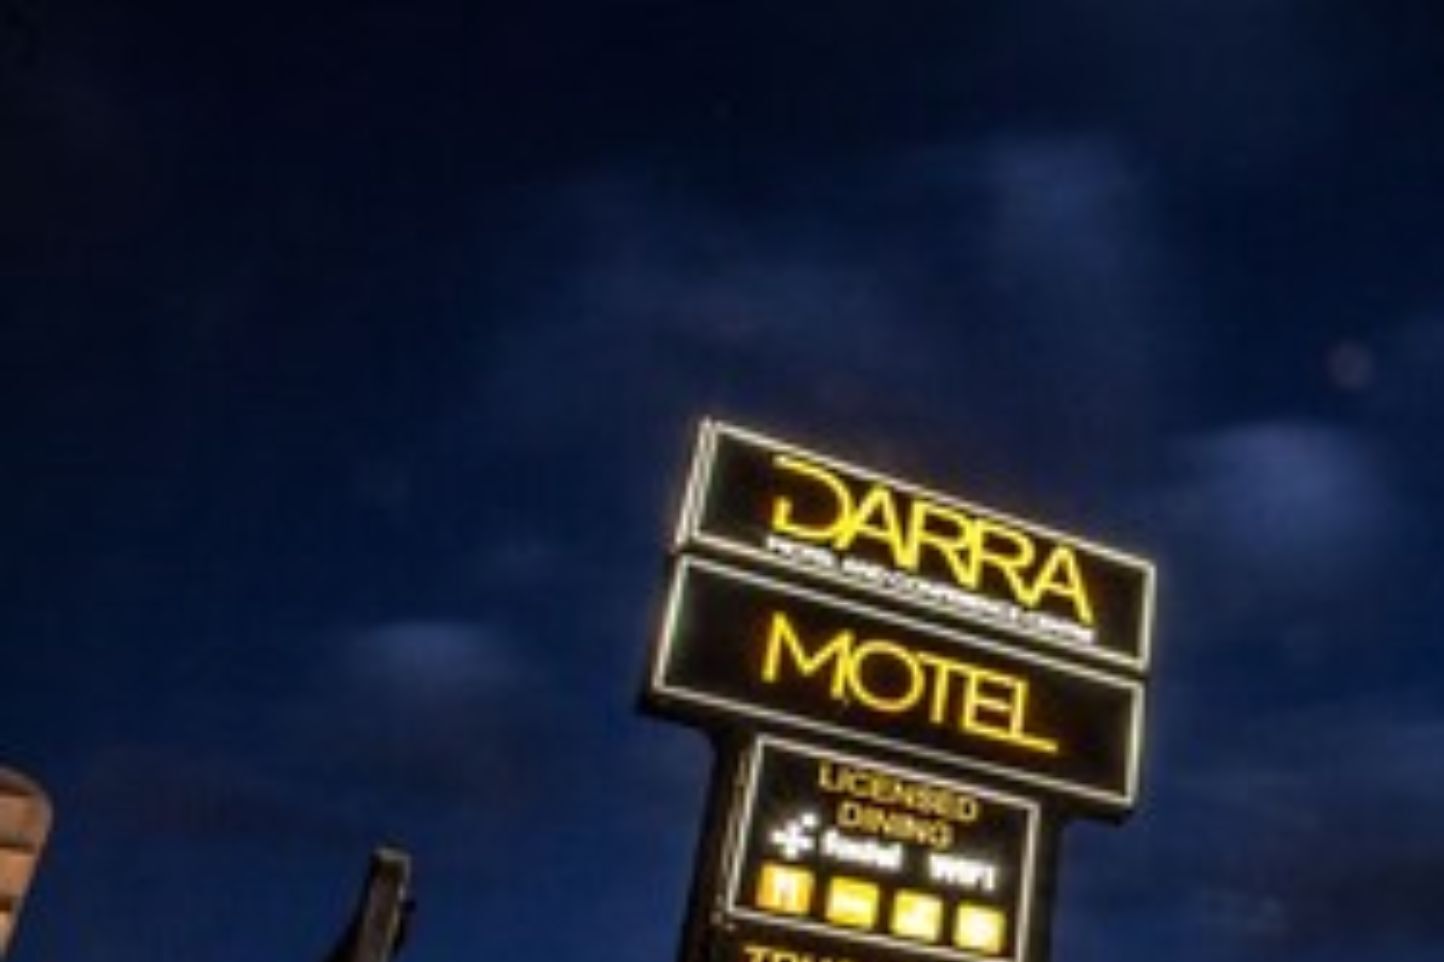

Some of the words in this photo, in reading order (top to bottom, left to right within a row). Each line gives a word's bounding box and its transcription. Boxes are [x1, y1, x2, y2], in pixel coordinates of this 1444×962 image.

[773, 455, 1094, 626] DARRA
[762, 612, 1058, 752] MOTEL
[818, 762, 979, 822] LICENSED
[837, 801, 953, 852] DINING
